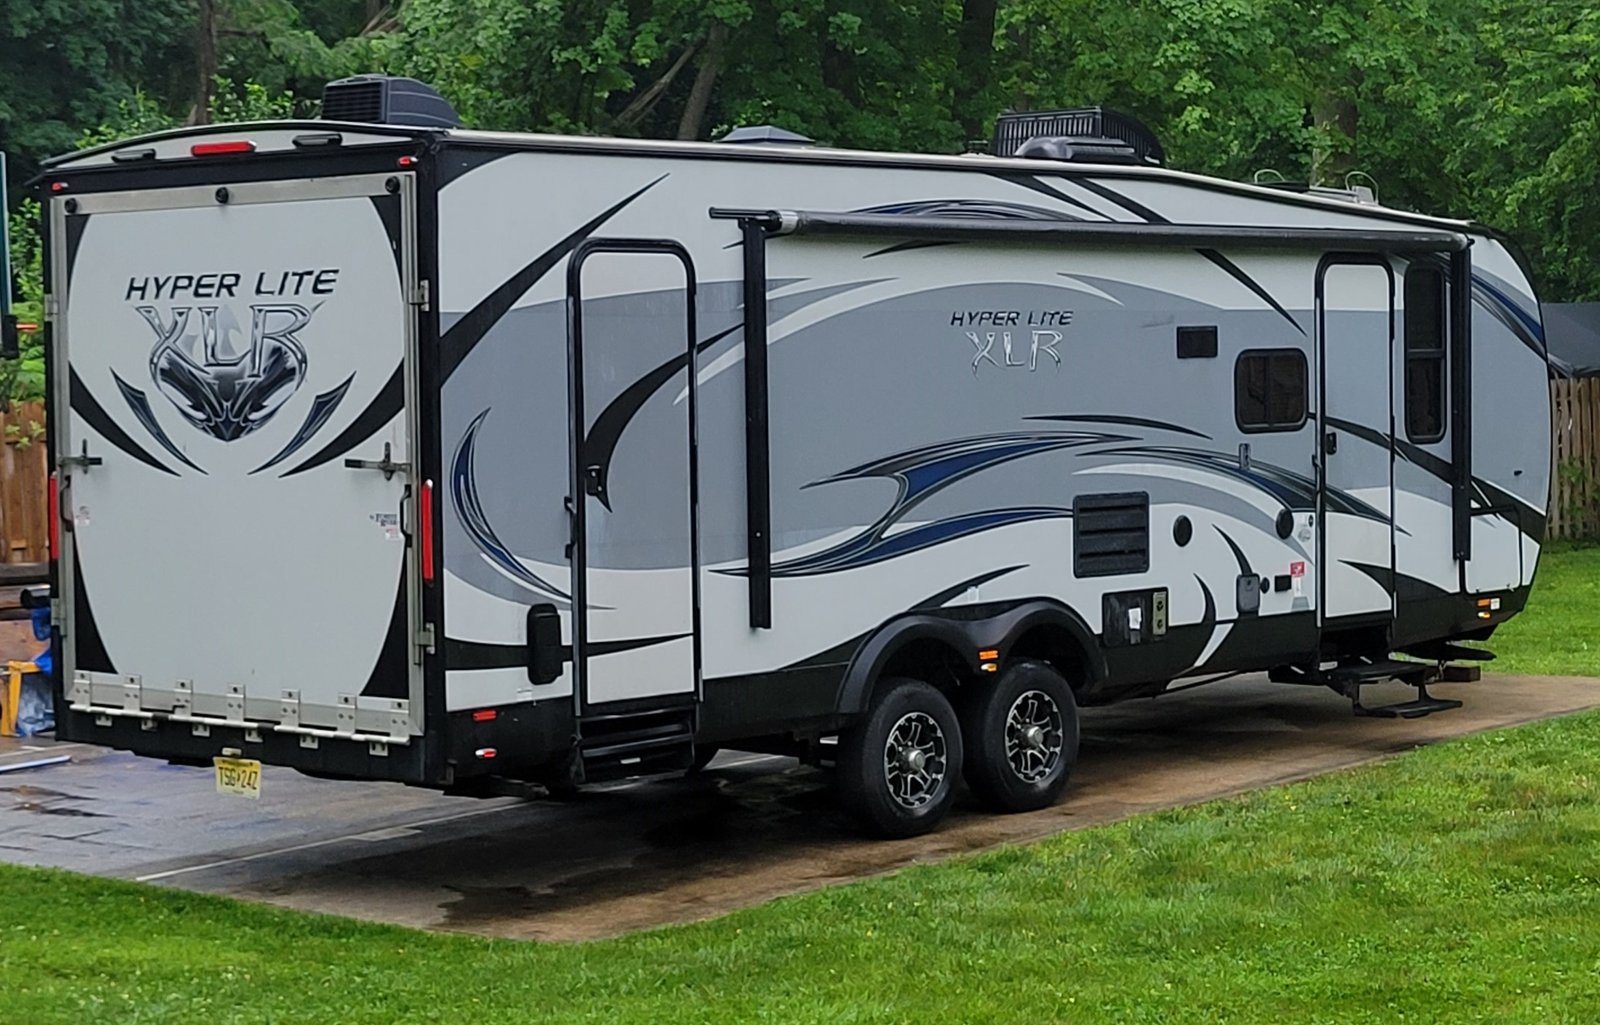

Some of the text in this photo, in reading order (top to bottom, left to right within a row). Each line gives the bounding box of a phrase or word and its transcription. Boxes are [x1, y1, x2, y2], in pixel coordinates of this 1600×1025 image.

[125, 269, 340, 300] HYPER LITE
[950, 310, 1074, 327] HYPER LITE
[135, 303, 308, 390] XLR
[965, 329, 1064, 380] XLR
